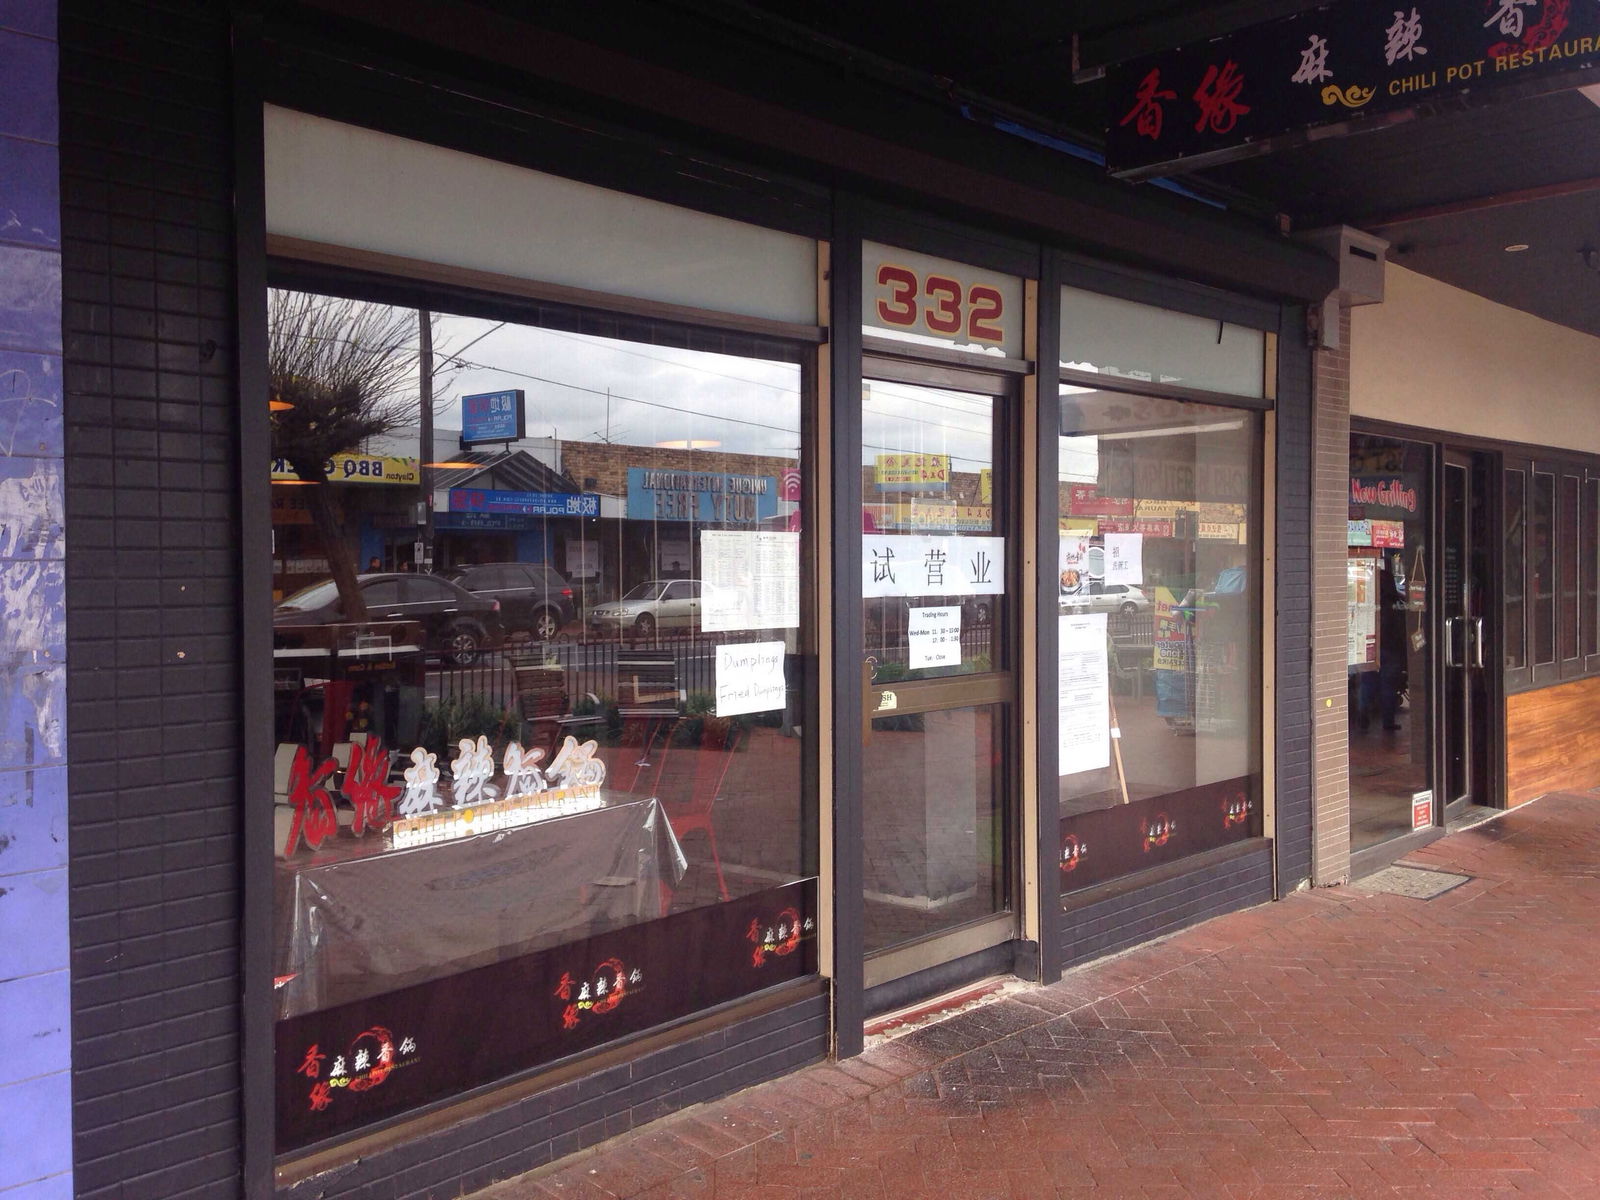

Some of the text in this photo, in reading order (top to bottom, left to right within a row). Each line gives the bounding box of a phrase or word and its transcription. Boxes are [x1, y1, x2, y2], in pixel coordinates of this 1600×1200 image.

[1388, 71, 1437, 97] CHILI
[1446, 60, 1484, 82] POT
[876, 263, 1004, 344] 332
[1351, 478, 1417, 512] Now Grilling
[869, 546, 993, 586] 试营业
[922, 611, 936, 619] Trading
